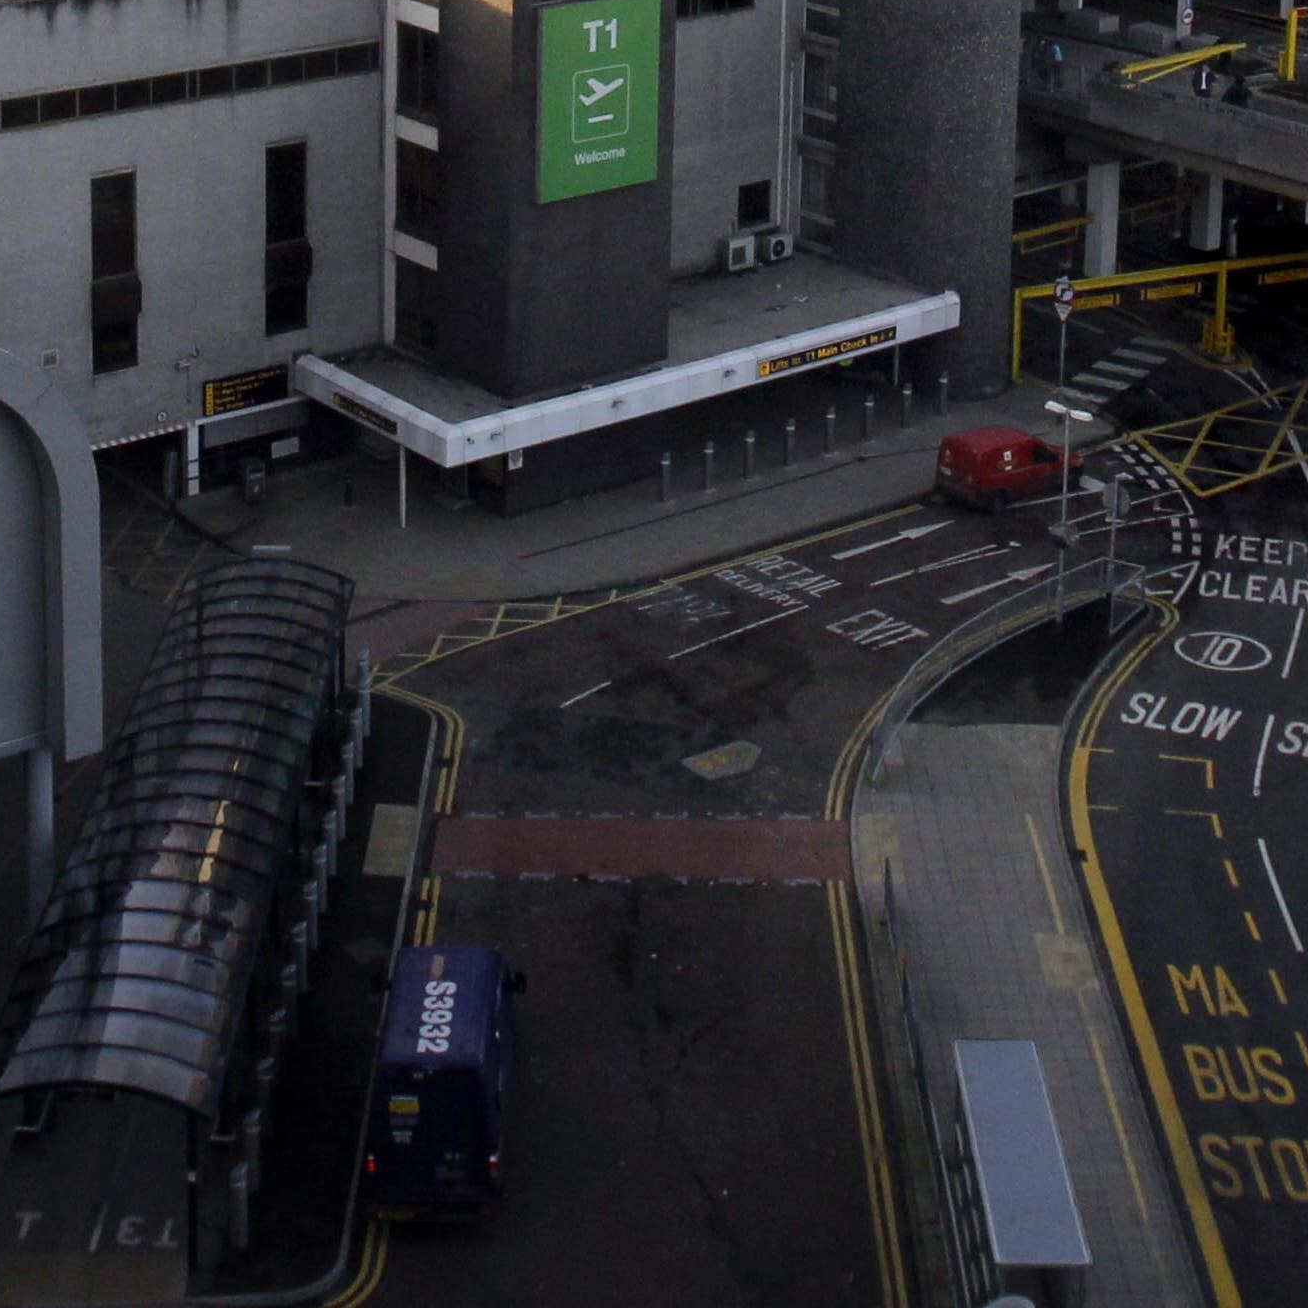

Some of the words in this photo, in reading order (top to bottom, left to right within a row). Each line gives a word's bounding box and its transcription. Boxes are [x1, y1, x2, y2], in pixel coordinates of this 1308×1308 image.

[583, 18, 618, 53] T1
[574, 148, 626, 165] Welcome
[818, 346, 838, 359] Main
[841, 338, 867, 352] Check
[1214, 534, 1308, 565] KEEP
[825, 609, 930, 650] EXIT
[1202, 636, 1242, 666] 10
[1120, 692, 1241, 742] SLOW
[1167, 964, 1249, 1019] MA
[417, 981, 457, 1053] S3932
[1183, 1044, 1293, 1106] BUS
